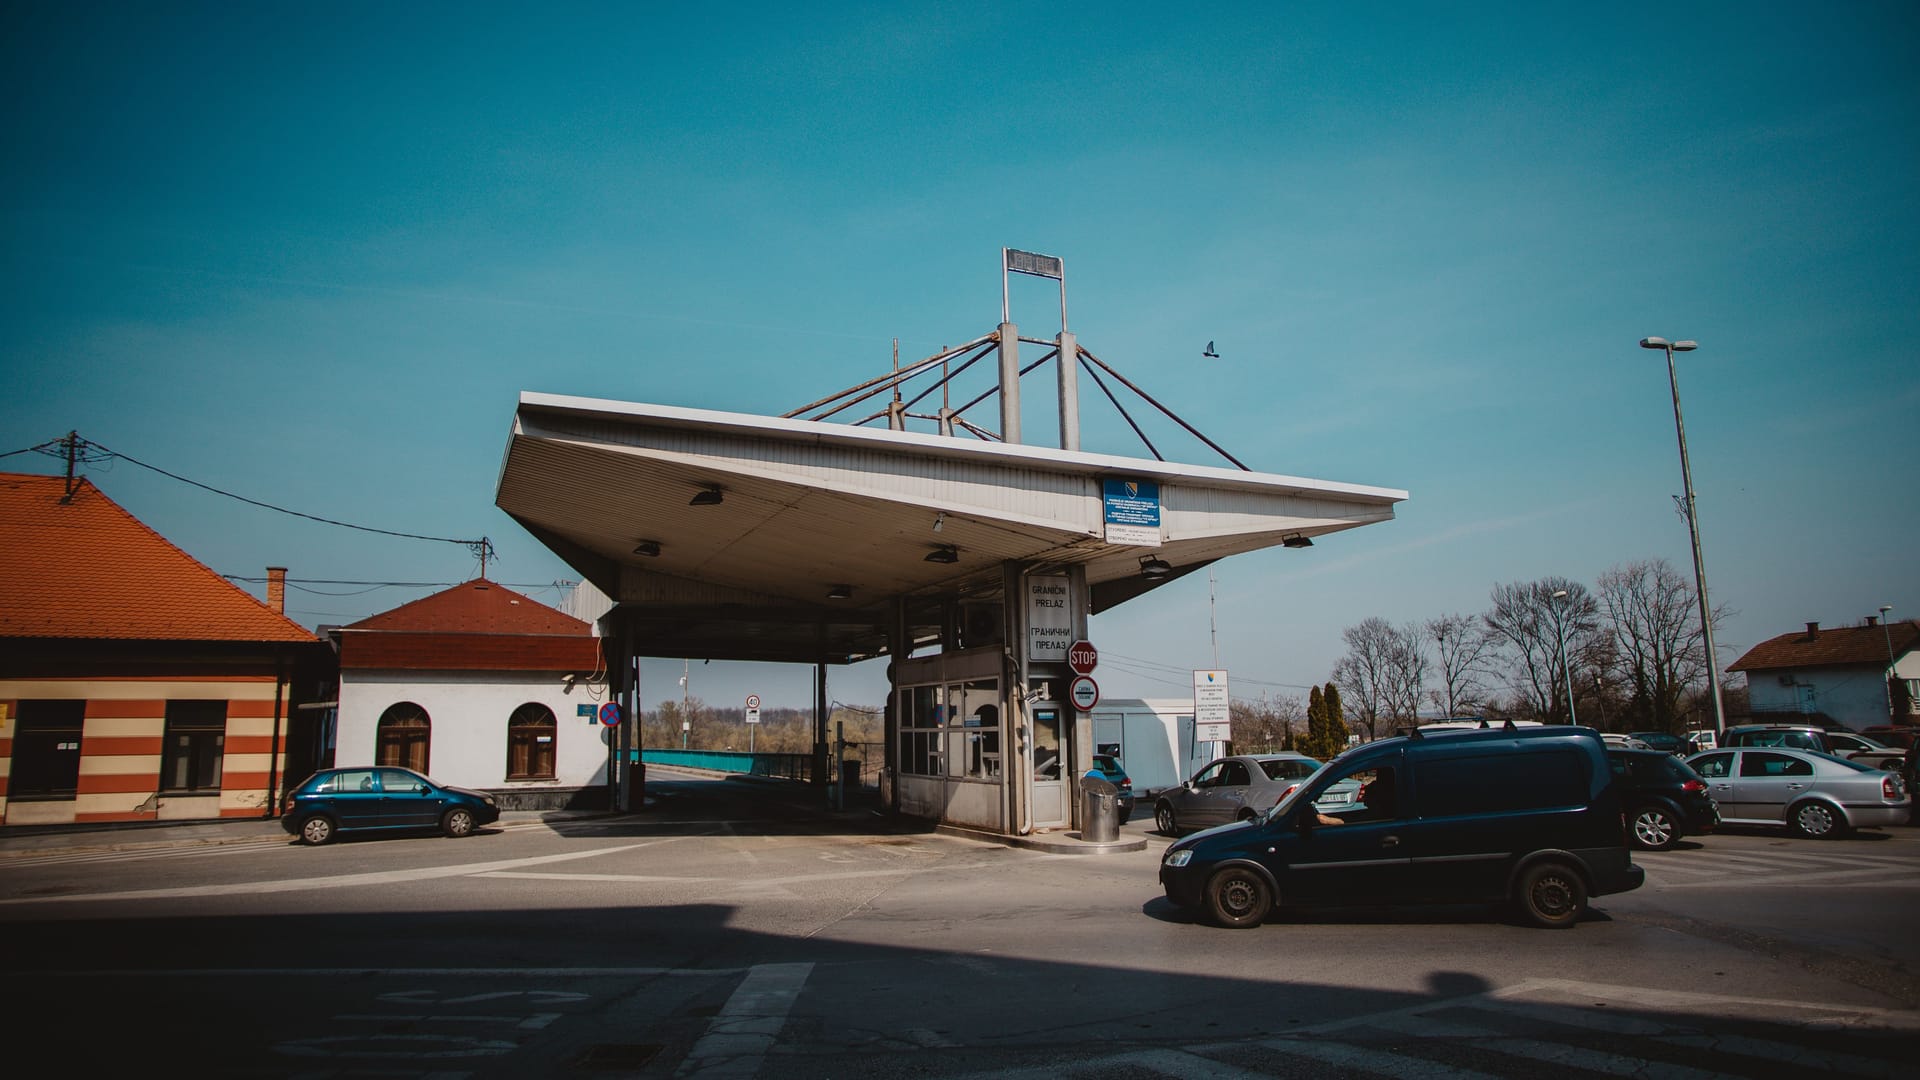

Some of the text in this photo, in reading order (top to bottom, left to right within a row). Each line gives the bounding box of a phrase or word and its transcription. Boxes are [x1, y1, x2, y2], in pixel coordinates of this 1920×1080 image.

[1032, 585, 1066, 595] GRANIČNI
[1035, 599, 1064, 608] PRELAZ
[1031, 627, 1071, 637] ГРАНИЧНИ
[1035, 641, 1066, 650] ПРЕЛАЗ
[1071, 651, 1096, 665] STOP
